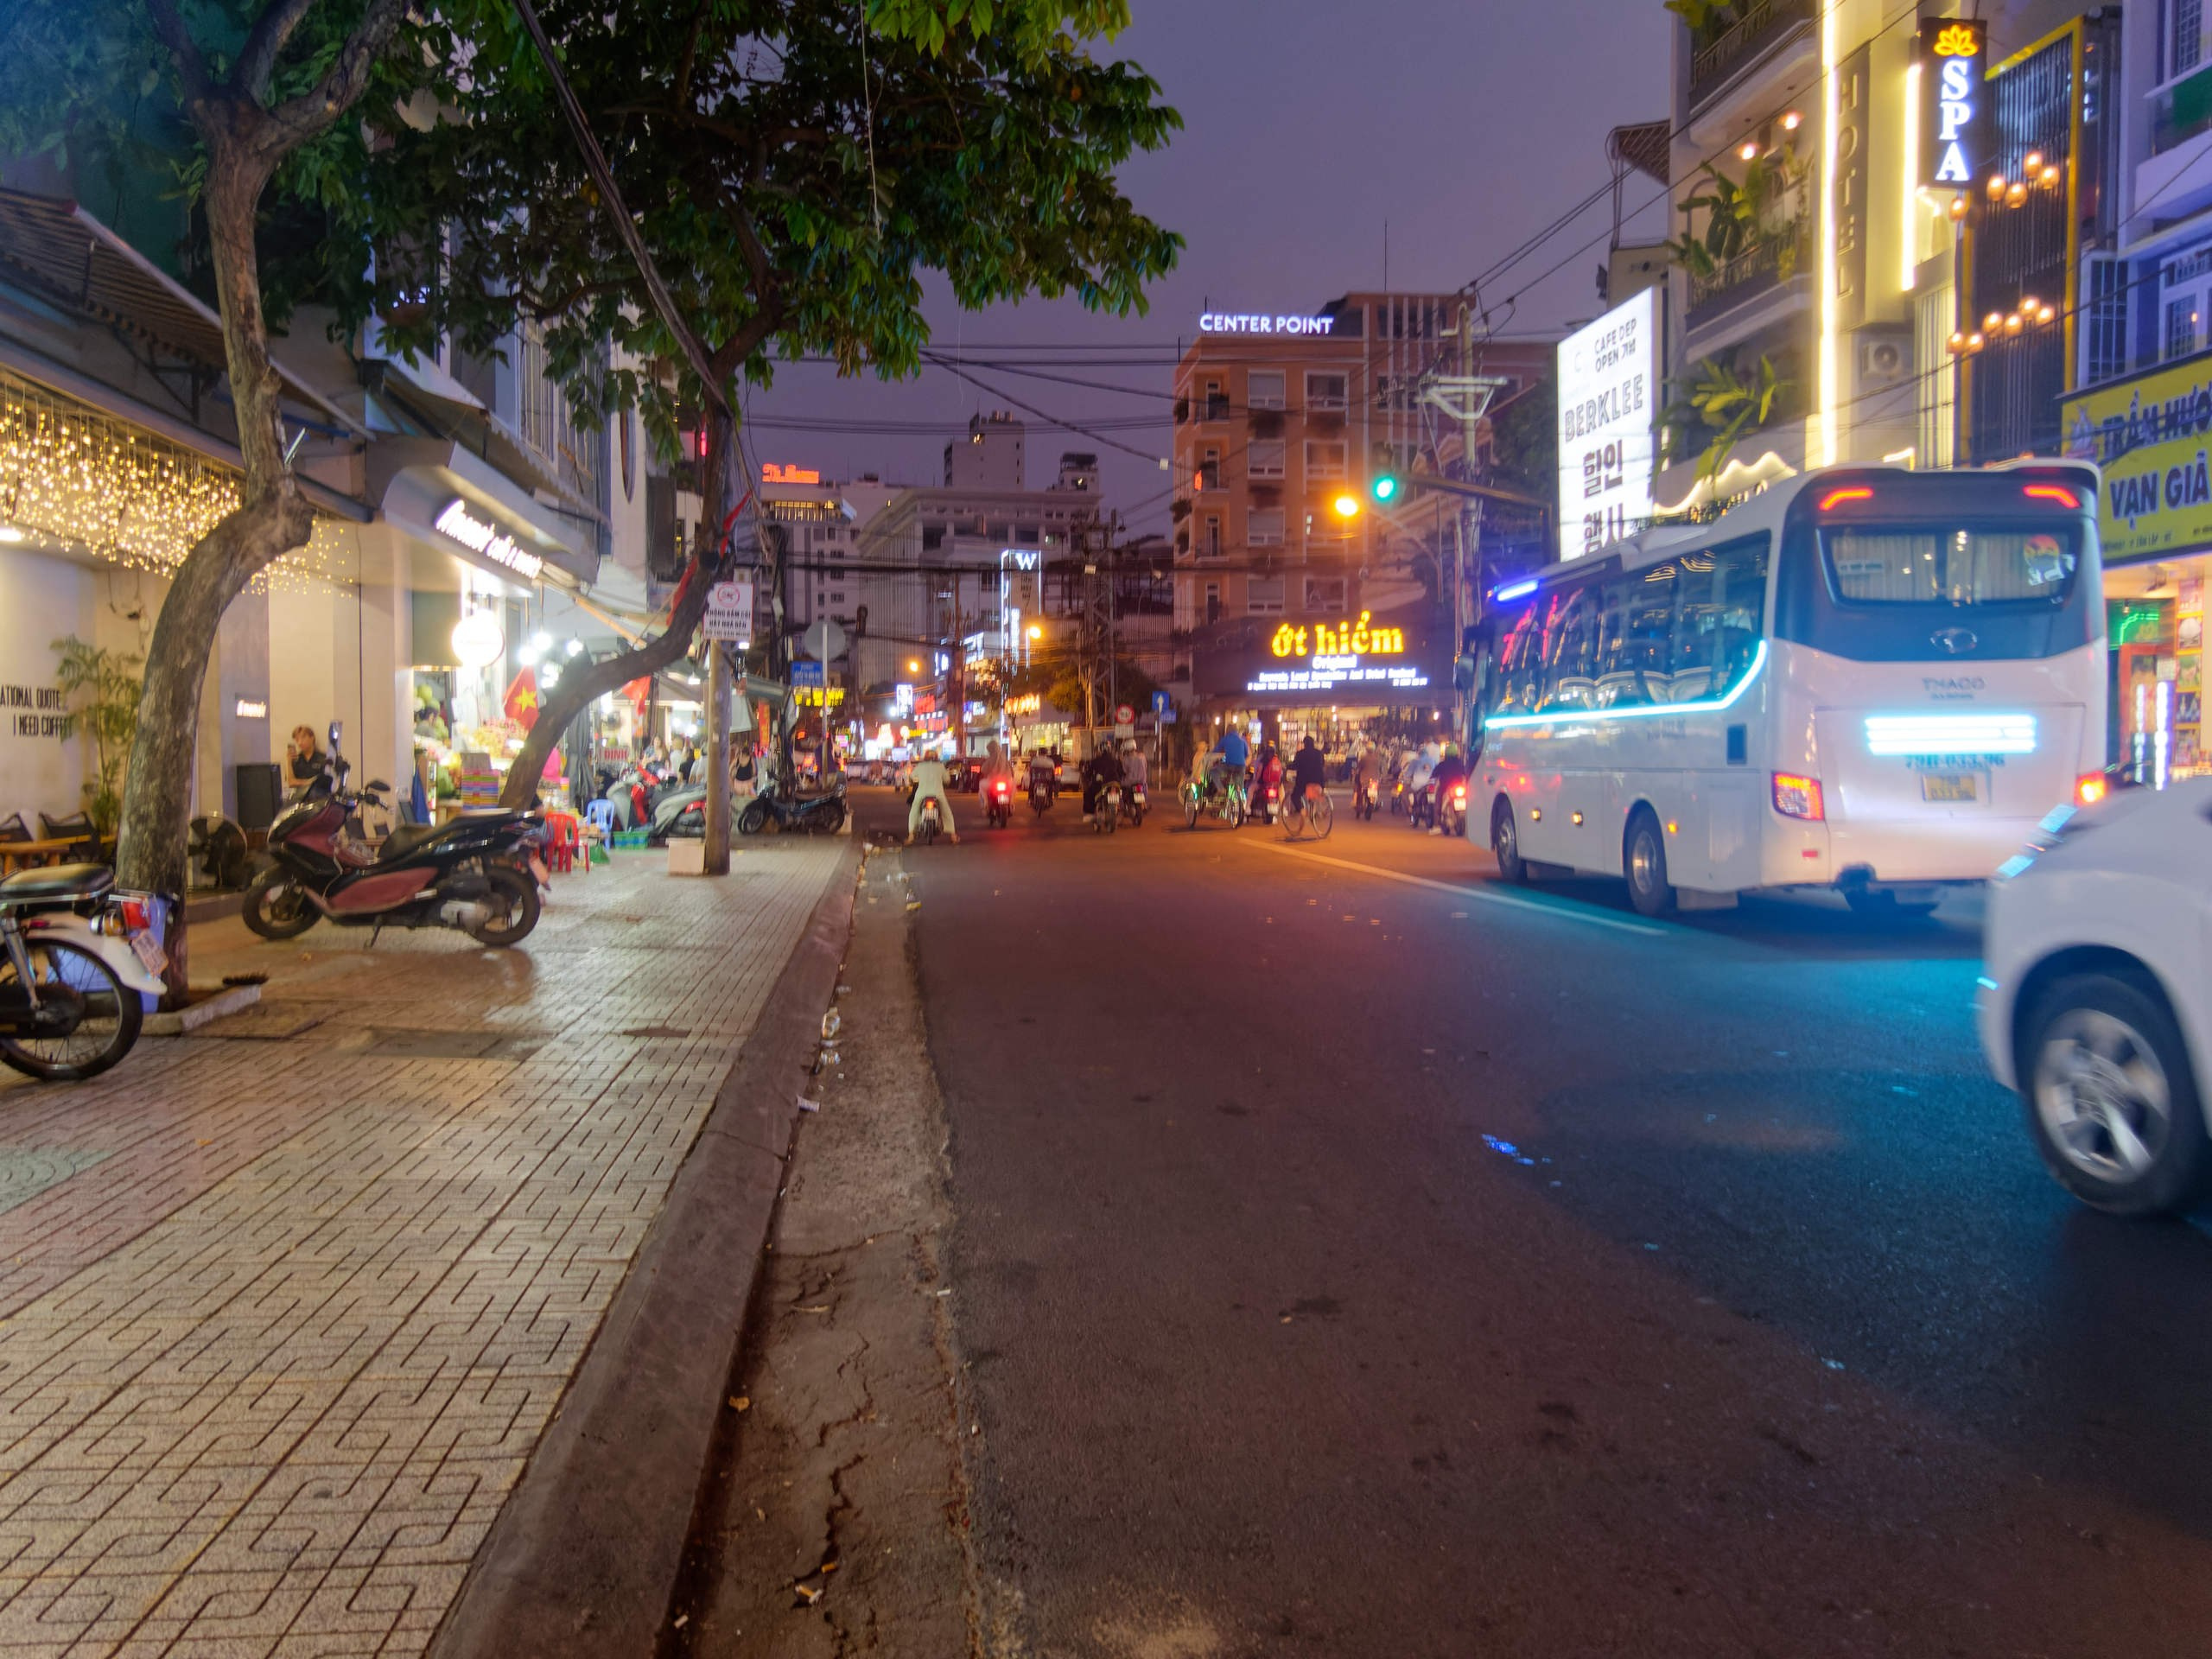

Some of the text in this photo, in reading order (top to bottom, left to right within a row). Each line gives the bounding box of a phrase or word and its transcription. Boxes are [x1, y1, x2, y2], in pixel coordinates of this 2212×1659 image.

[1936, 59, 1972, 181] SPA
[1836, 73, 1859, 300] HOTEL
[1199, 313, 1334, 335] CENTER POINT
[1594, 328, 1617, 354] CAFE
[1595, 347, 1619, 373] OPEN
[1564, 373, 1643, 443] BERKLEE
[1583, 439, 1624, 499] 할인
[2109, 449, 2211, 531] VẠN GIÃ
[1014, 552, 1037, 570] W
[1922, 677, 1986, 691] THACO
[36, 688, 68, 711] QUOTE
[13, 713, 72, 738] I NEED COFF
